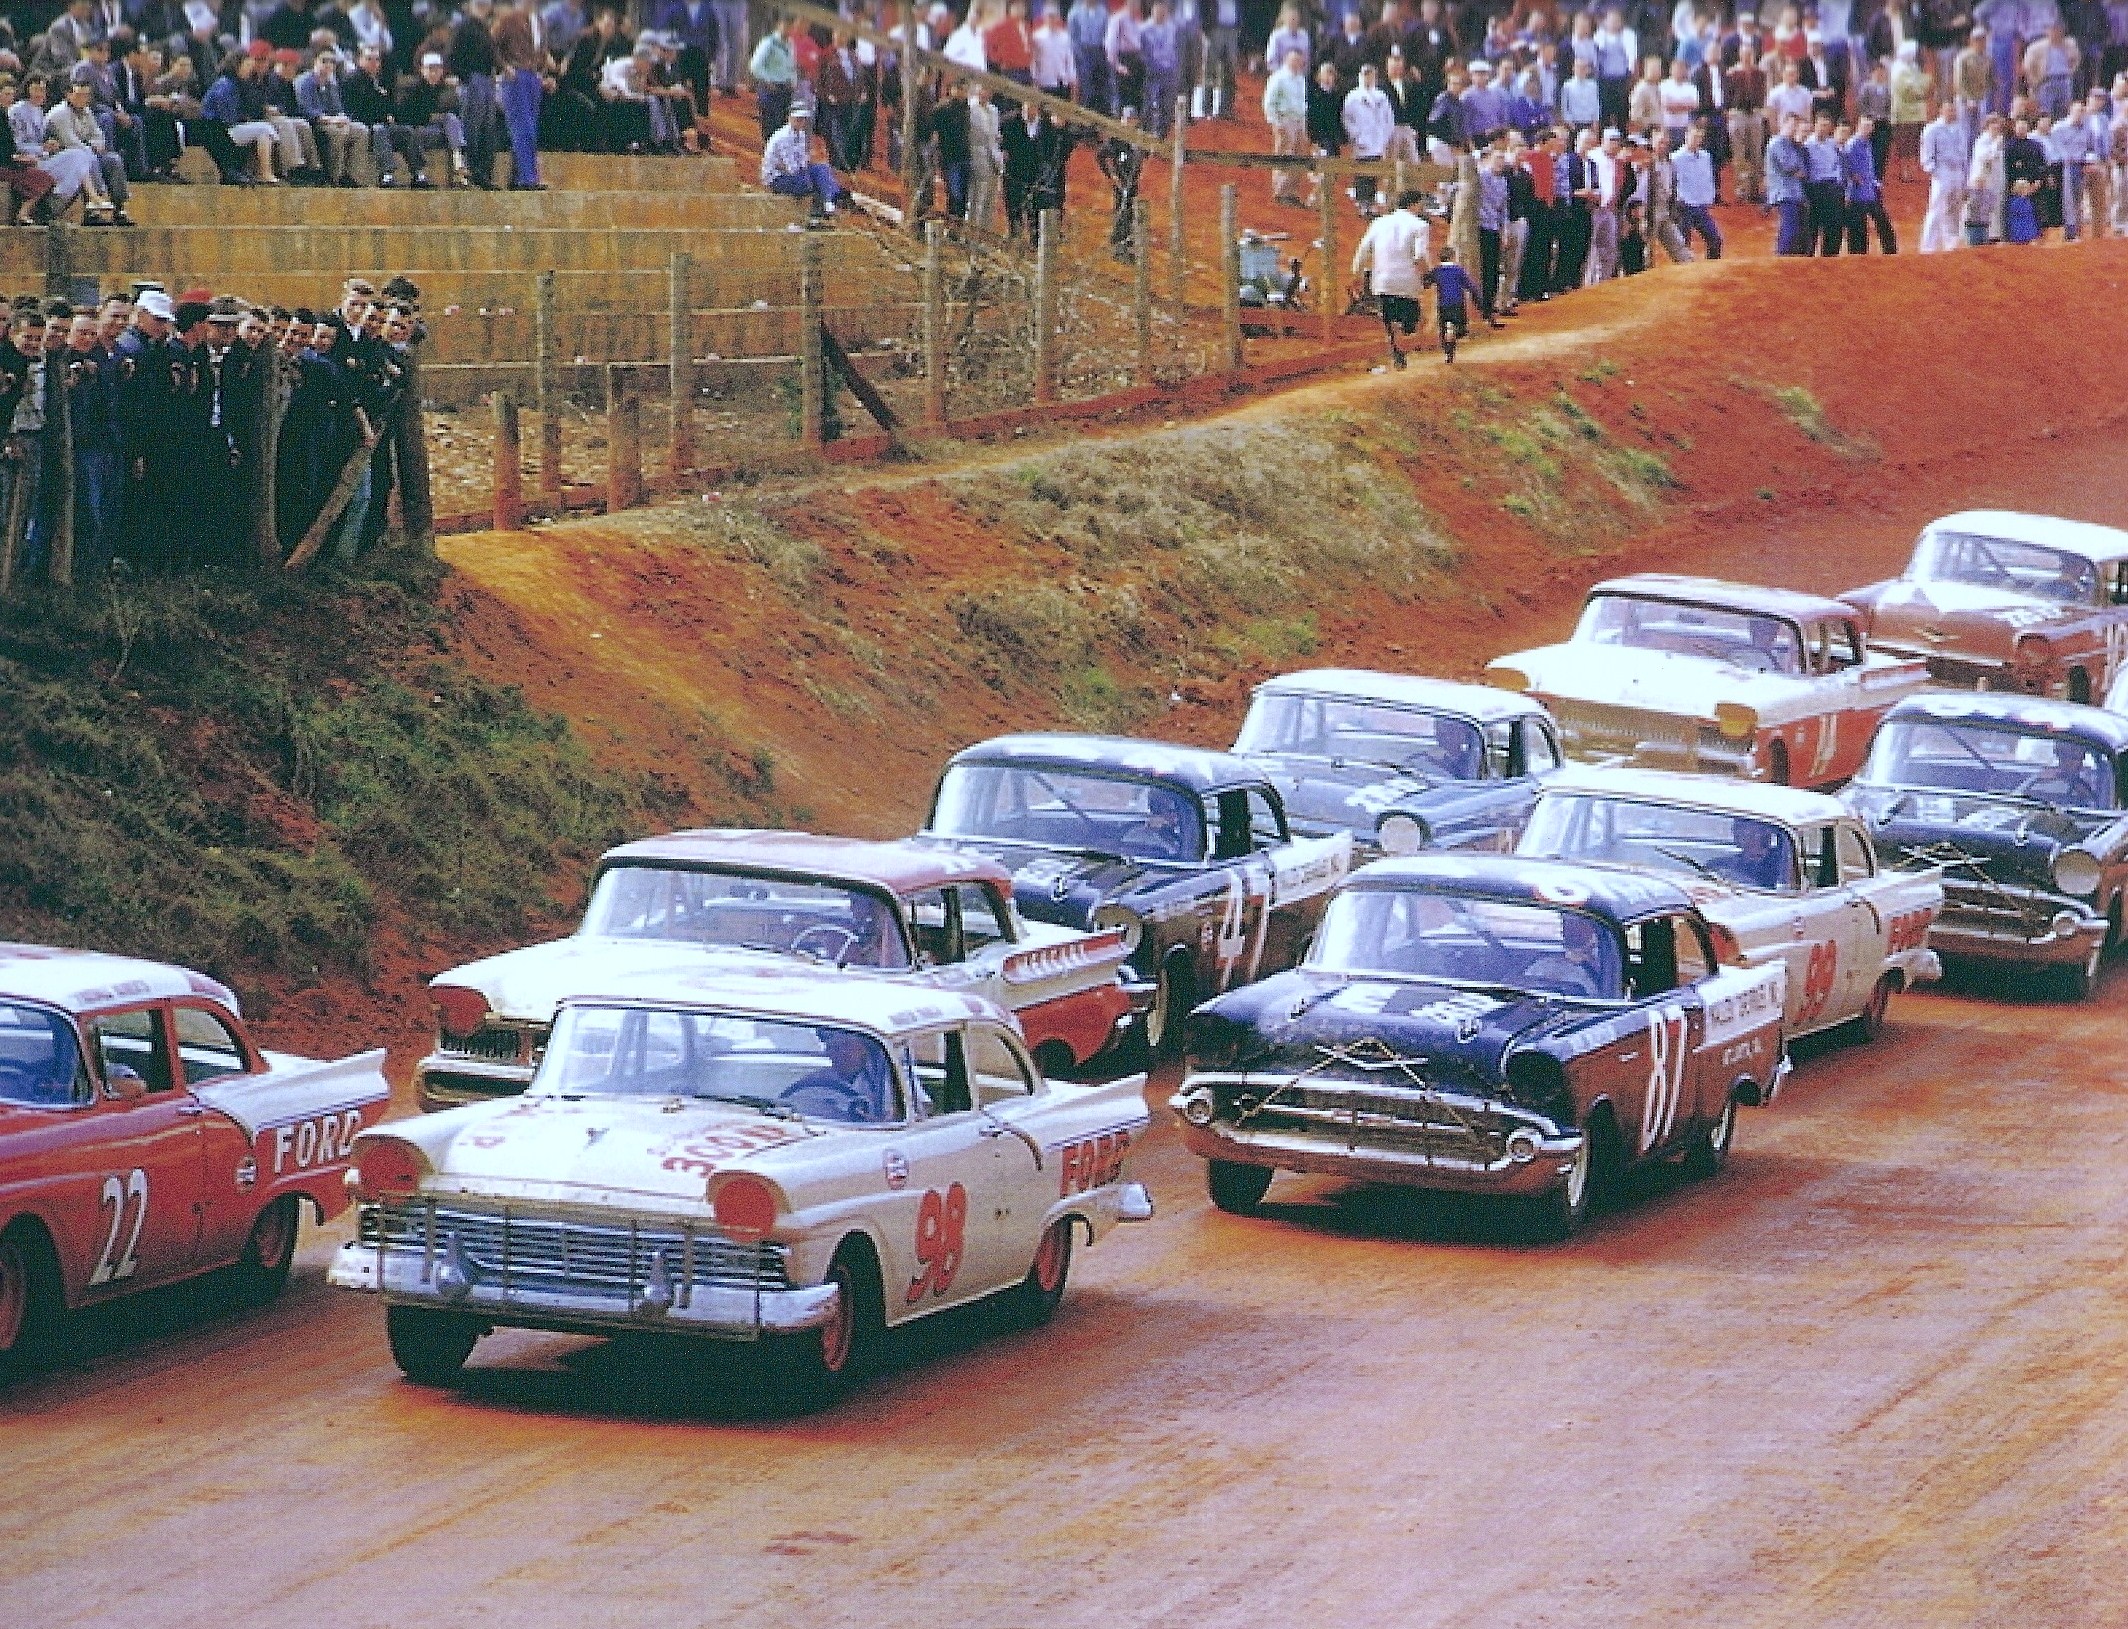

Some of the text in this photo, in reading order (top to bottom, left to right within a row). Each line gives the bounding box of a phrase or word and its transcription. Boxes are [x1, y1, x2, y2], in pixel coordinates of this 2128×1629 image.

[1217, 866, 1270, 991] 47
[1639, 1007, 1687, 1153] 87
[275, 1109, 361, 1175] FORD
[88, 1167, 148, 1284] 22
[906, 1181, 967, 1304] 98
